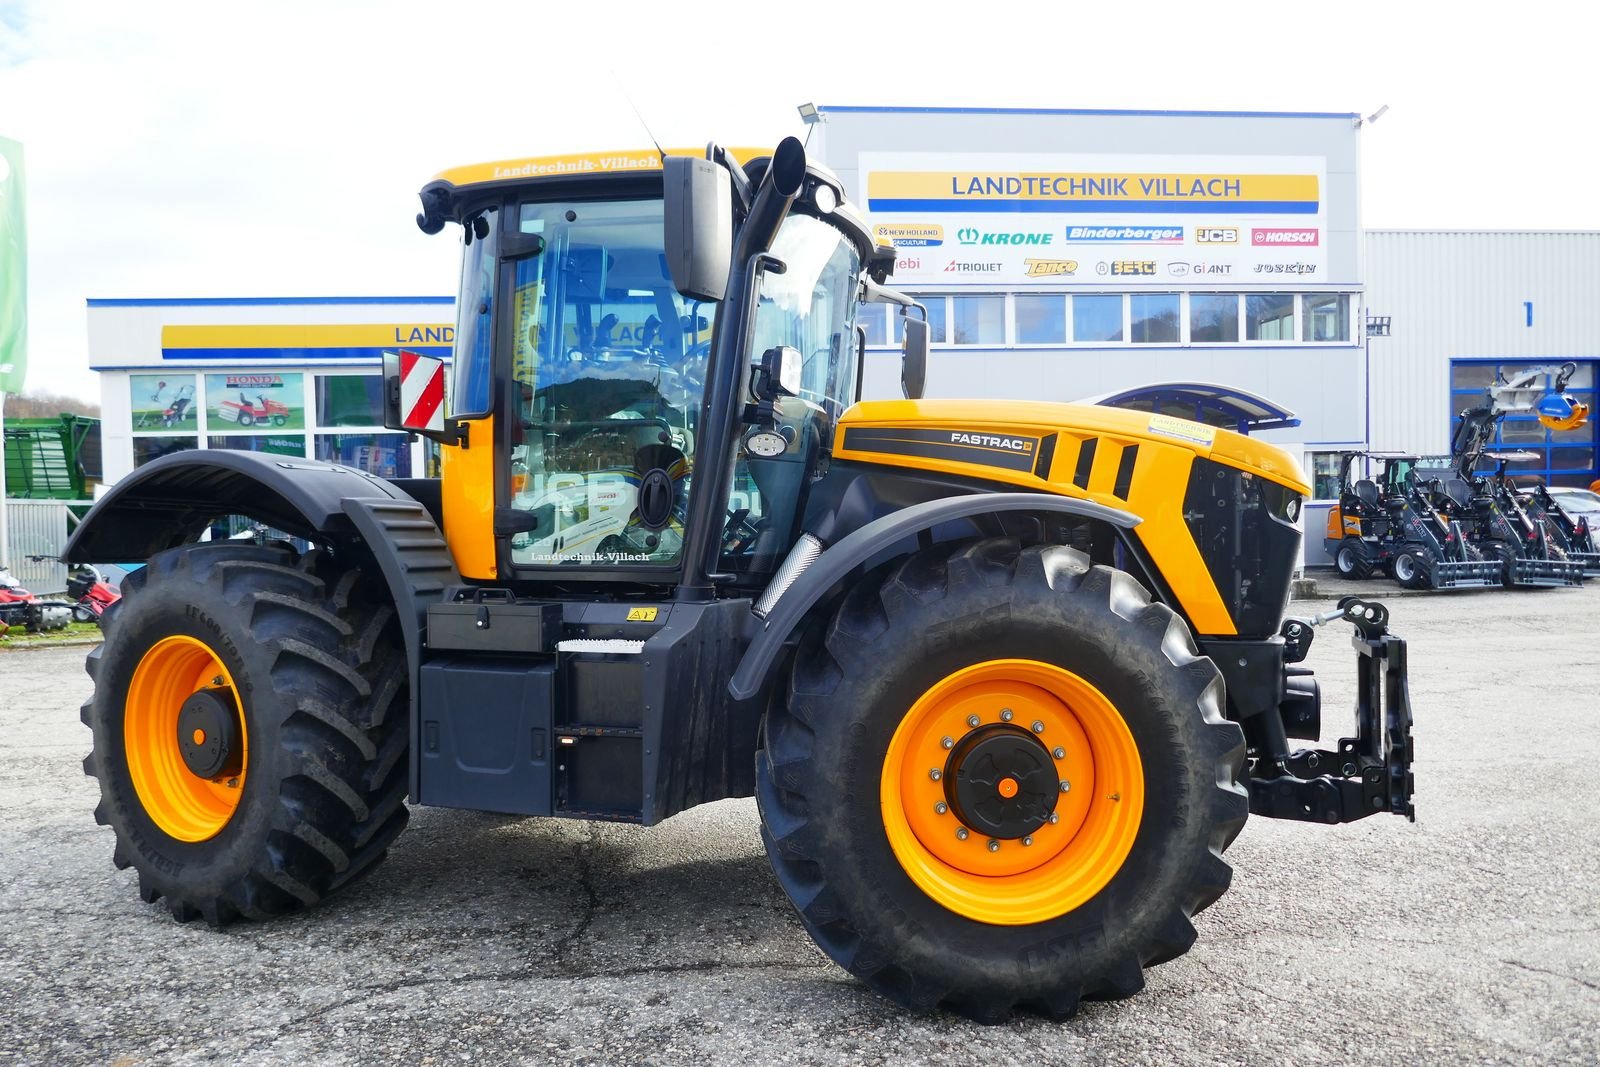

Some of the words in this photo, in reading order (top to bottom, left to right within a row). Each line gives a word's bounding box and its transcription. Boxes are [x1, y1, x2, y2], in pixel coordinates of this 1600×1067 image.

[493, 156, 659, 178] Landtechnik-Villach
[952, 176, 1128, 196] LANDTECHNIK
[1138, 178, 1241, 197] VILLACH
[981, 233, 1054, 245] KRONE
[1069, 227, 1181, 240] Binderberger
[1197, 229, 1237, 242] JCB
[1265, 232, 1315, 243] HORSCH
[956, 263, 1002, 272] TRIOLIET
[1024, 259, 1078, 277] Tanco
[1523, 302, 1533, 327] 1
[226, 375, 284, 384] HONDA
[951, 432, 1023, 450] FASTRAC
[530, 552, 650, 562] Landtechnik-Villach
